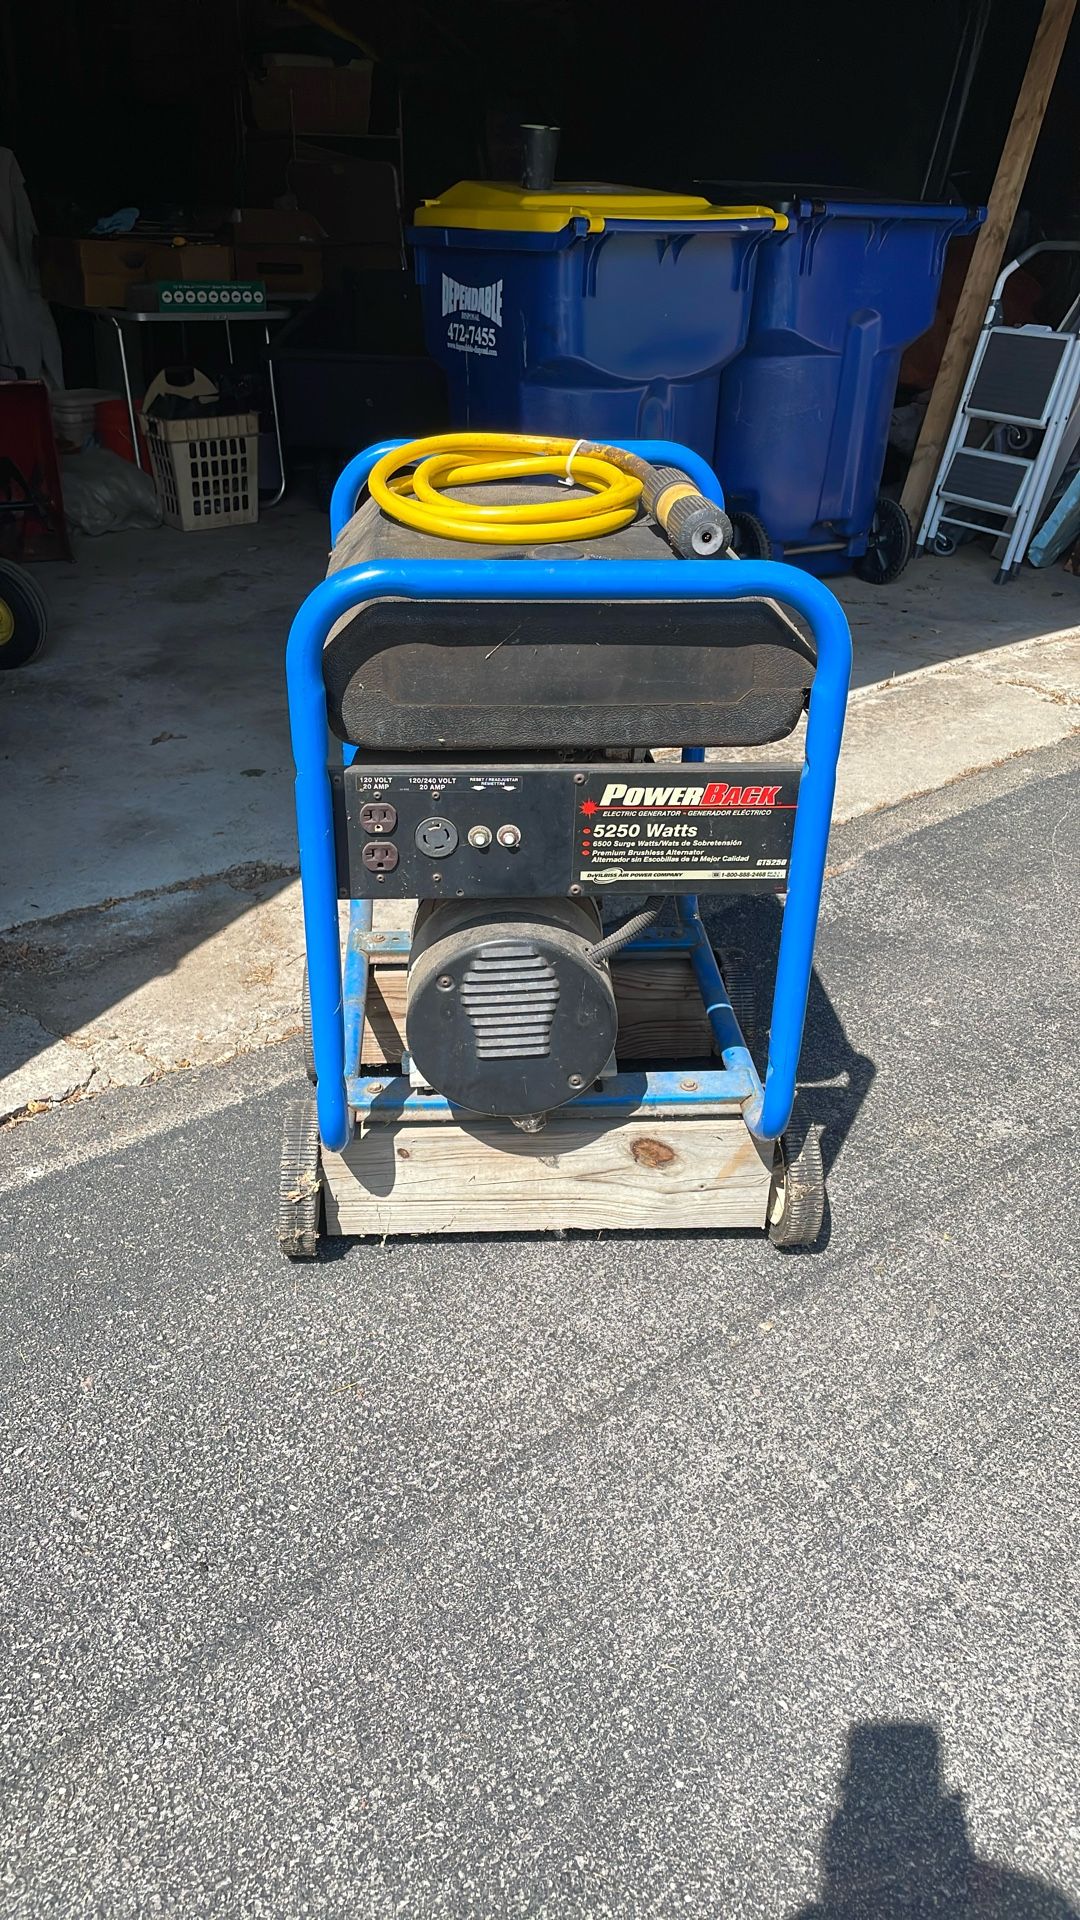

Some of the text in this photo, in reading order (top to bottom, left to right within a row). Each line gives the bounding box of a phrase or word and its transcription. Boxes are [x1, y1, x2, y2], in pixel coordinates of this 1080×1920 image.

[442, 272, 503, 328] DEPENDABLE
[448, 323, 496, 347] 472-7455
[599, 783, 783, 806] POWERBACK
[732, 808, 772, 816] ELÉCTRICO
[593, 823, 698, 838] 5250 Watts
[613, 840, 636, 848] Surge
[692, 839, 742, 847] Sobretensión
[699, 855, 721, 863] Mejor
[756, 858, 787, 866] GT5250
